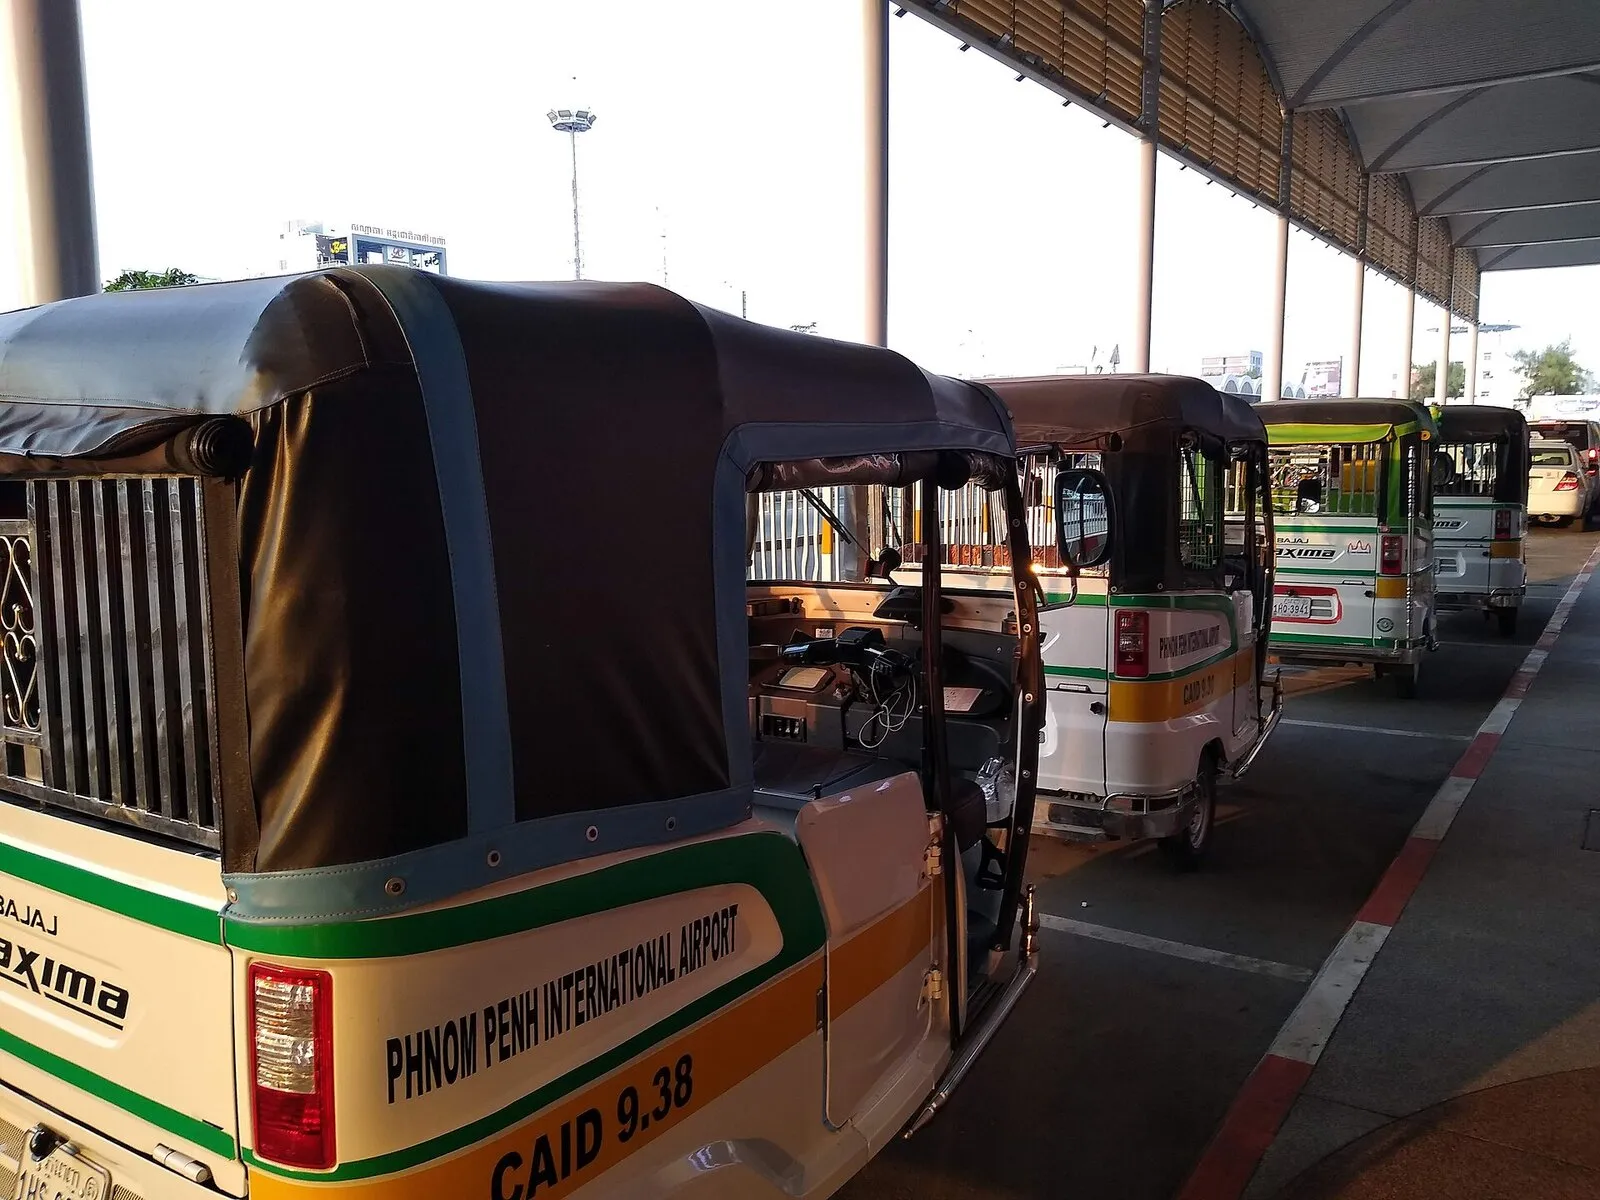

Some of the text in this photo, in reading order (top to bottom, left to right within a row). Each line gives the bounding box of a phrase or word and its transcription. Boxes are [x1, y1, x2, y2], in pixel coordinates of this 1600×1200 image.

[386, 903, 739, 1104] PHNOM PENH INTERNATIONAL AIRPORT
[490, 1053, 694, 1200] CAID 9.38
